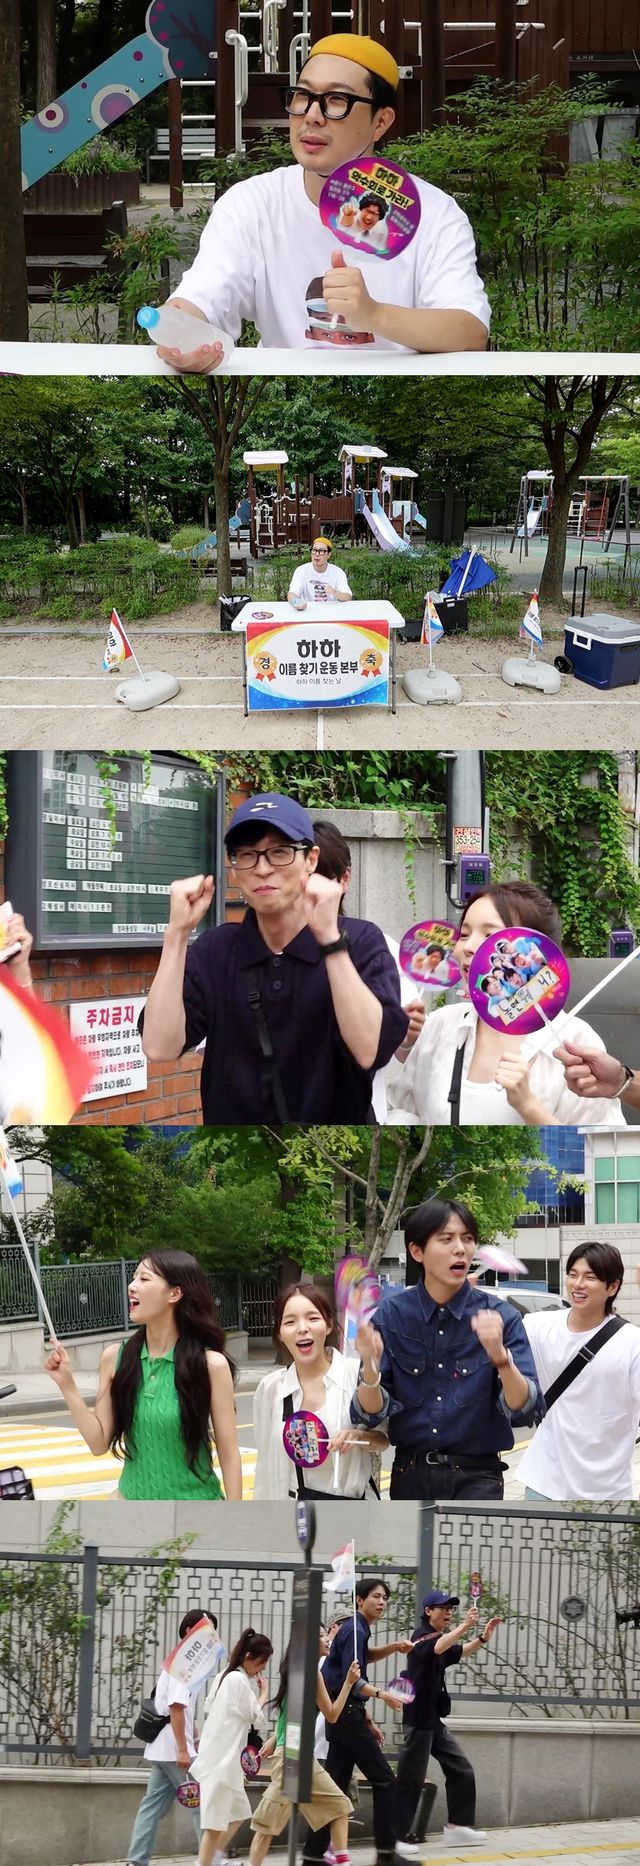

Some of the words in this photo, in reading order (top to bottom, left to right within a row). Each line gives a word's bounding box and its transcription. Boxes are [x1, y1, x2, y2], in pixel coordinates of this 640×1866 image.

[385, 189, 409, 208] 가라!
[296, 639, 341, 658] 하하
[260, 657, 270, 670] 경
[279, 663, 297, 676] 이름
[299, 662, 318, 676] 찾기
[320, 661, 338, 675] 운동
[340, 660, 358, 674] 본부
[365, 654, 376, 666] 축
[87, 1005, 134, 1028] 주차금지
